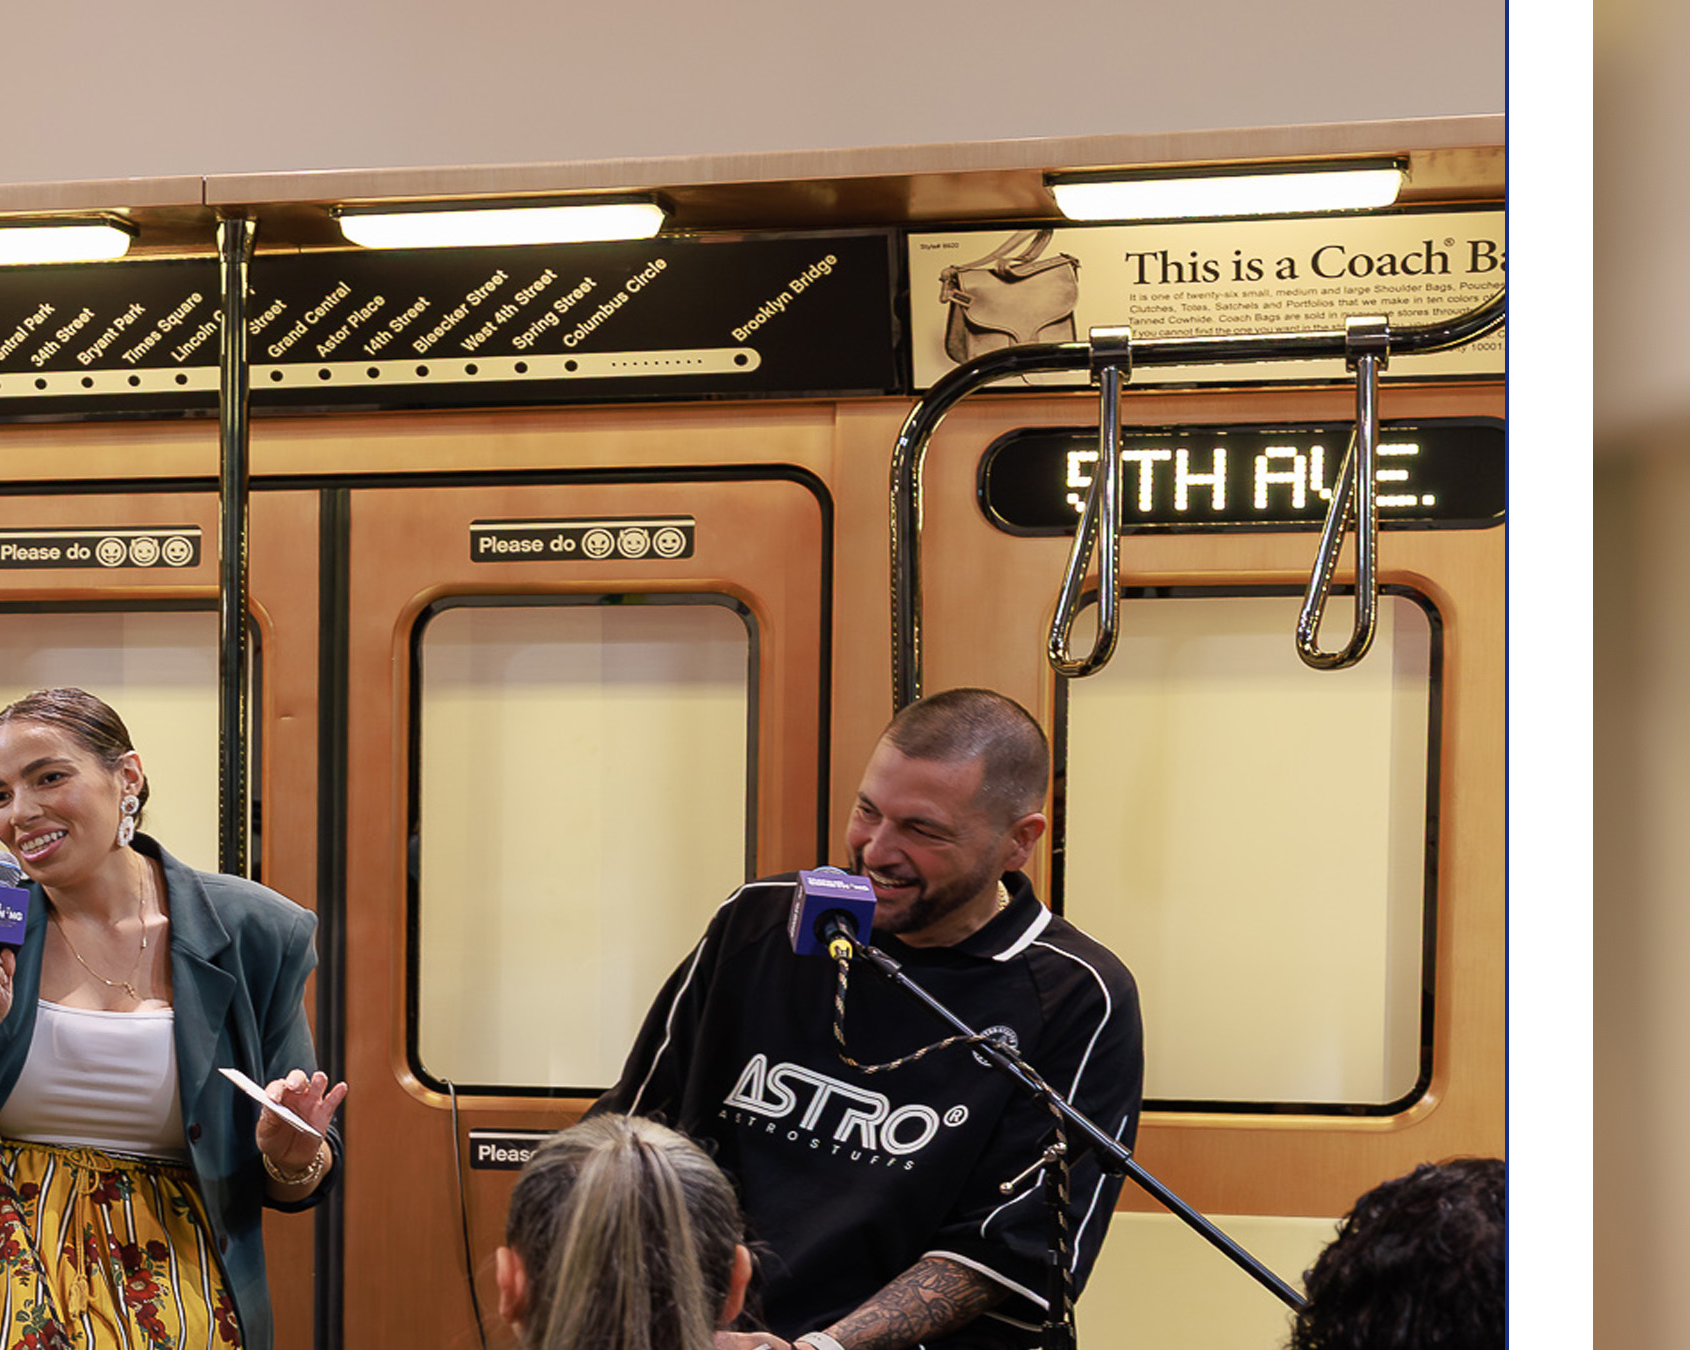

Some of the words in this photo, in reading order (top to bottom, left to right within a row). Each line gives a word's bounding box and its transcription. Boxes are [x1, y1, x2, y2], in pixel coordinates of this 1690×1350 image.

[1125, 249, 1220, 285] This
[1231, 249, 1264, 282] is
[1275, 256, 1299, 280] a
[1466, 239, 1506, 275] B
[1129, 293, 1137, 301] It
[1139, 293, 1148, 301] is
[1173, 292, 1185, 300] of
[1186, 291, 1238, 301] twenty-six
[1276, 287, 1318, 296] medium
[1321, 286, 1341, 295] and
[1343, 286, 1371, 296] large
[1373, 283, 1422, 293] Shoulder
[22, 302, 56, 331] Park
[121, 330, 162, 364] Times
[157, 291, 203, 333] Square
[248, 299, 287, 335] Street
[267, 319, 308, 358] Grand
[303, 280, 352, 325] Central
[315, 324, 352, 358] Astor
[346, 294, 386, 328] Place
[363, 329, 394, 356] 14th
[388, 296, 431, 333] Street
[411, 302, 469, 354] Bleecker
[465, 269, 509, 306] Street
[460, 320, 498, 351] West
[494, 303, 519, 325] 4th
[514, 268, 558, 306] Street
[511, 310, 560, 350] Spring
[553, 276, 598, 314] Street
[562, 291, 629, 348] Columbus
[625, 258, 668, 293] Circle
[731, 291, 794, 342] Brooklyn
[788, 253, 837, 294] Bridge
[1128, 316, 1165, 325] Tanned
[1218, 314, 1252, 323] Coach
[1254, 312, 1280, 322] Bags
[1304, 311, 1326, 320] sold
[1328, 311, 1338, 319] in
[1397, 308, 1429, 317] stores
[1214, 301, 1259, 311] Satchels
[1262, 301, 1282, 309] and
[1286, 299, 1334, 309] Portfolios
[1338, 298, 1359, 307] that
[1381, 296, 1410, 305] make
[1413, 296, 1423, 304] in
[1427, 295, 1444, 304] ten
[1447, 293, 1479, 303] colors
[30, 340, 61, 367] 34th
[55, 306, 95, 343] Street
[76, 327, 120, 366] Bryant
[112, 302, 146, 332] Park
[170, 321, 217, 362] Lincoln
[1138, 329, 1157, 338] you
[1158, 328, 1193, 337] cannot
[1194, 327, 1213, 335] find
[1215, 326, 1232, 335] the
[1066, 446, 1227, 512] 5TH
[0, 543, 61, 560] Please
[66, 542, 91, 560] do
[479, 535, 544, 553] Please
[549, 534, 576, 552] do
[717, 1108, 916, 1170] ASTROSTUFFS
